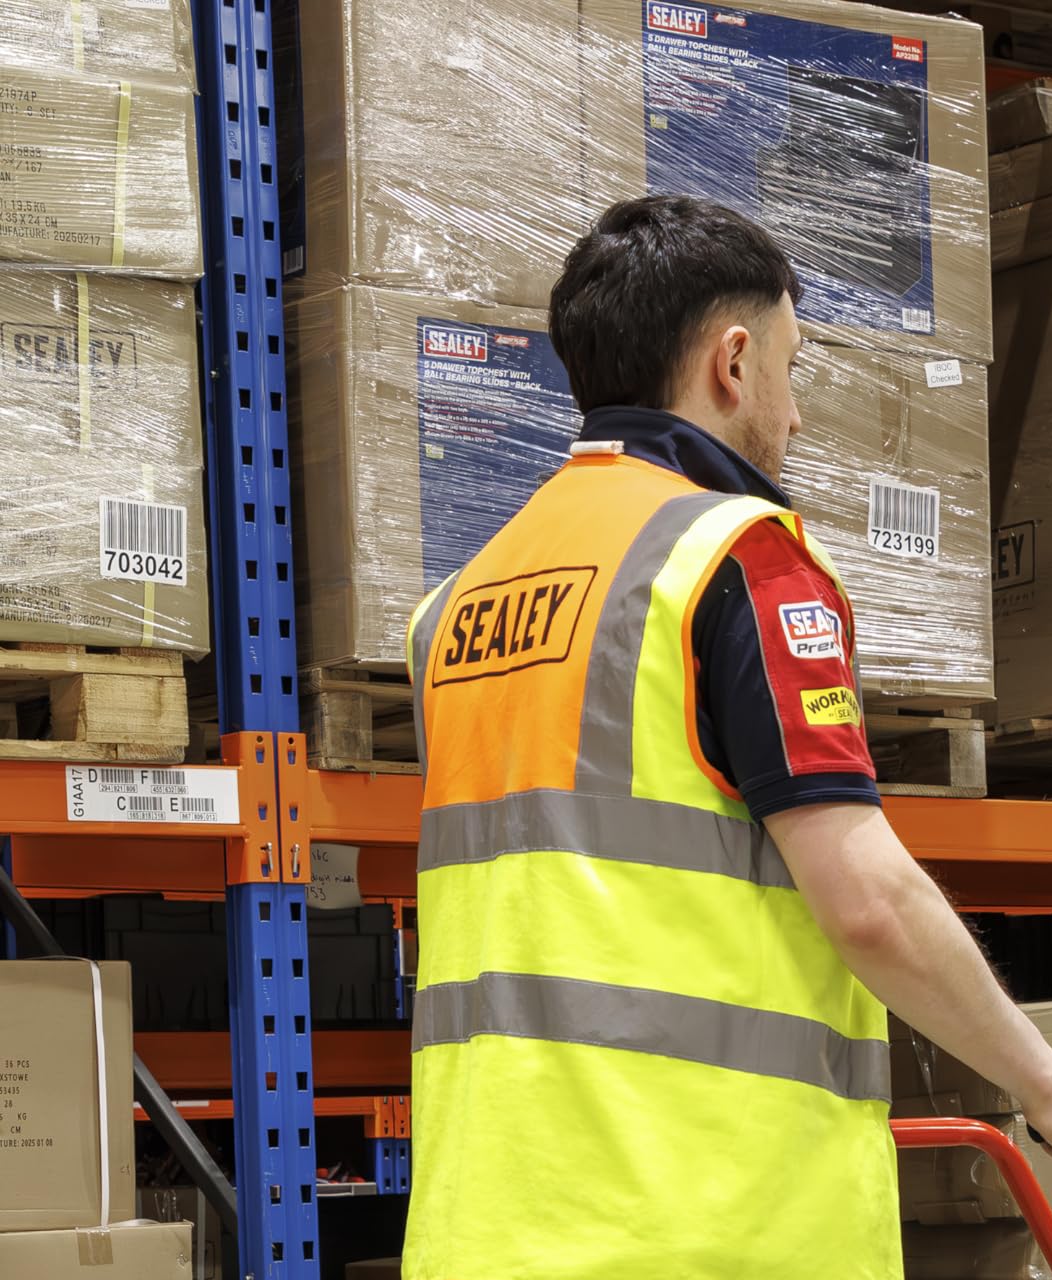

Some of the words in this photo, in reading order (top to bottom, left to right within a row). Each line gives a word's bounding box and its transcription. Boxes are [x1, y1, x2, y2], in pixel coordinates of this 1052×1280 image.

[652, 6, 702, 33] SEALEY
[648, 43, 667, 53] BALL
[668, 47, 701, 59] BEARING
[703, 53, 729, 64] SLIDES
[734, 59, 759, 68] BLACK
[654, 35, 687, 47] DRAWER
[688, 41, 727, 54] TOPCHEST
[728, 48, 749, 58] WITH
[13, 332, 124, 378] SEALEY
[428, 331, 482, 357] SEALEY
[424, 370, 445, 381] BALL
[445, 372, 481, 385] BEARING
[482, 377, 510, 388] SLIDES
[515, 381, 541, 391] BLACK
[430, 361, 465, 374] DRAWER
[467, 366, 509, 378] TOPCHEST
[510, 371, 531, 380] WITH
[871, 529, 935, 556] 723199
[104, 550, 184, 580] 703042
[444, 582, 576, 667] SEALEY
[789, 611, 836, 636] SEA
[806, 689, 858, 715] WORK
[88, 769, 97, 783] D
[141, 770, 148, 784] F
[72, 769, 84, 817] G1AA17
[117, 796, 126, 811] C
[170, 797, 179, 812] E
[17, 1060, 30, 1068] PCS
[18, 1112, 27, 1121] KG
[10, 1126, 21, 1134] CM
